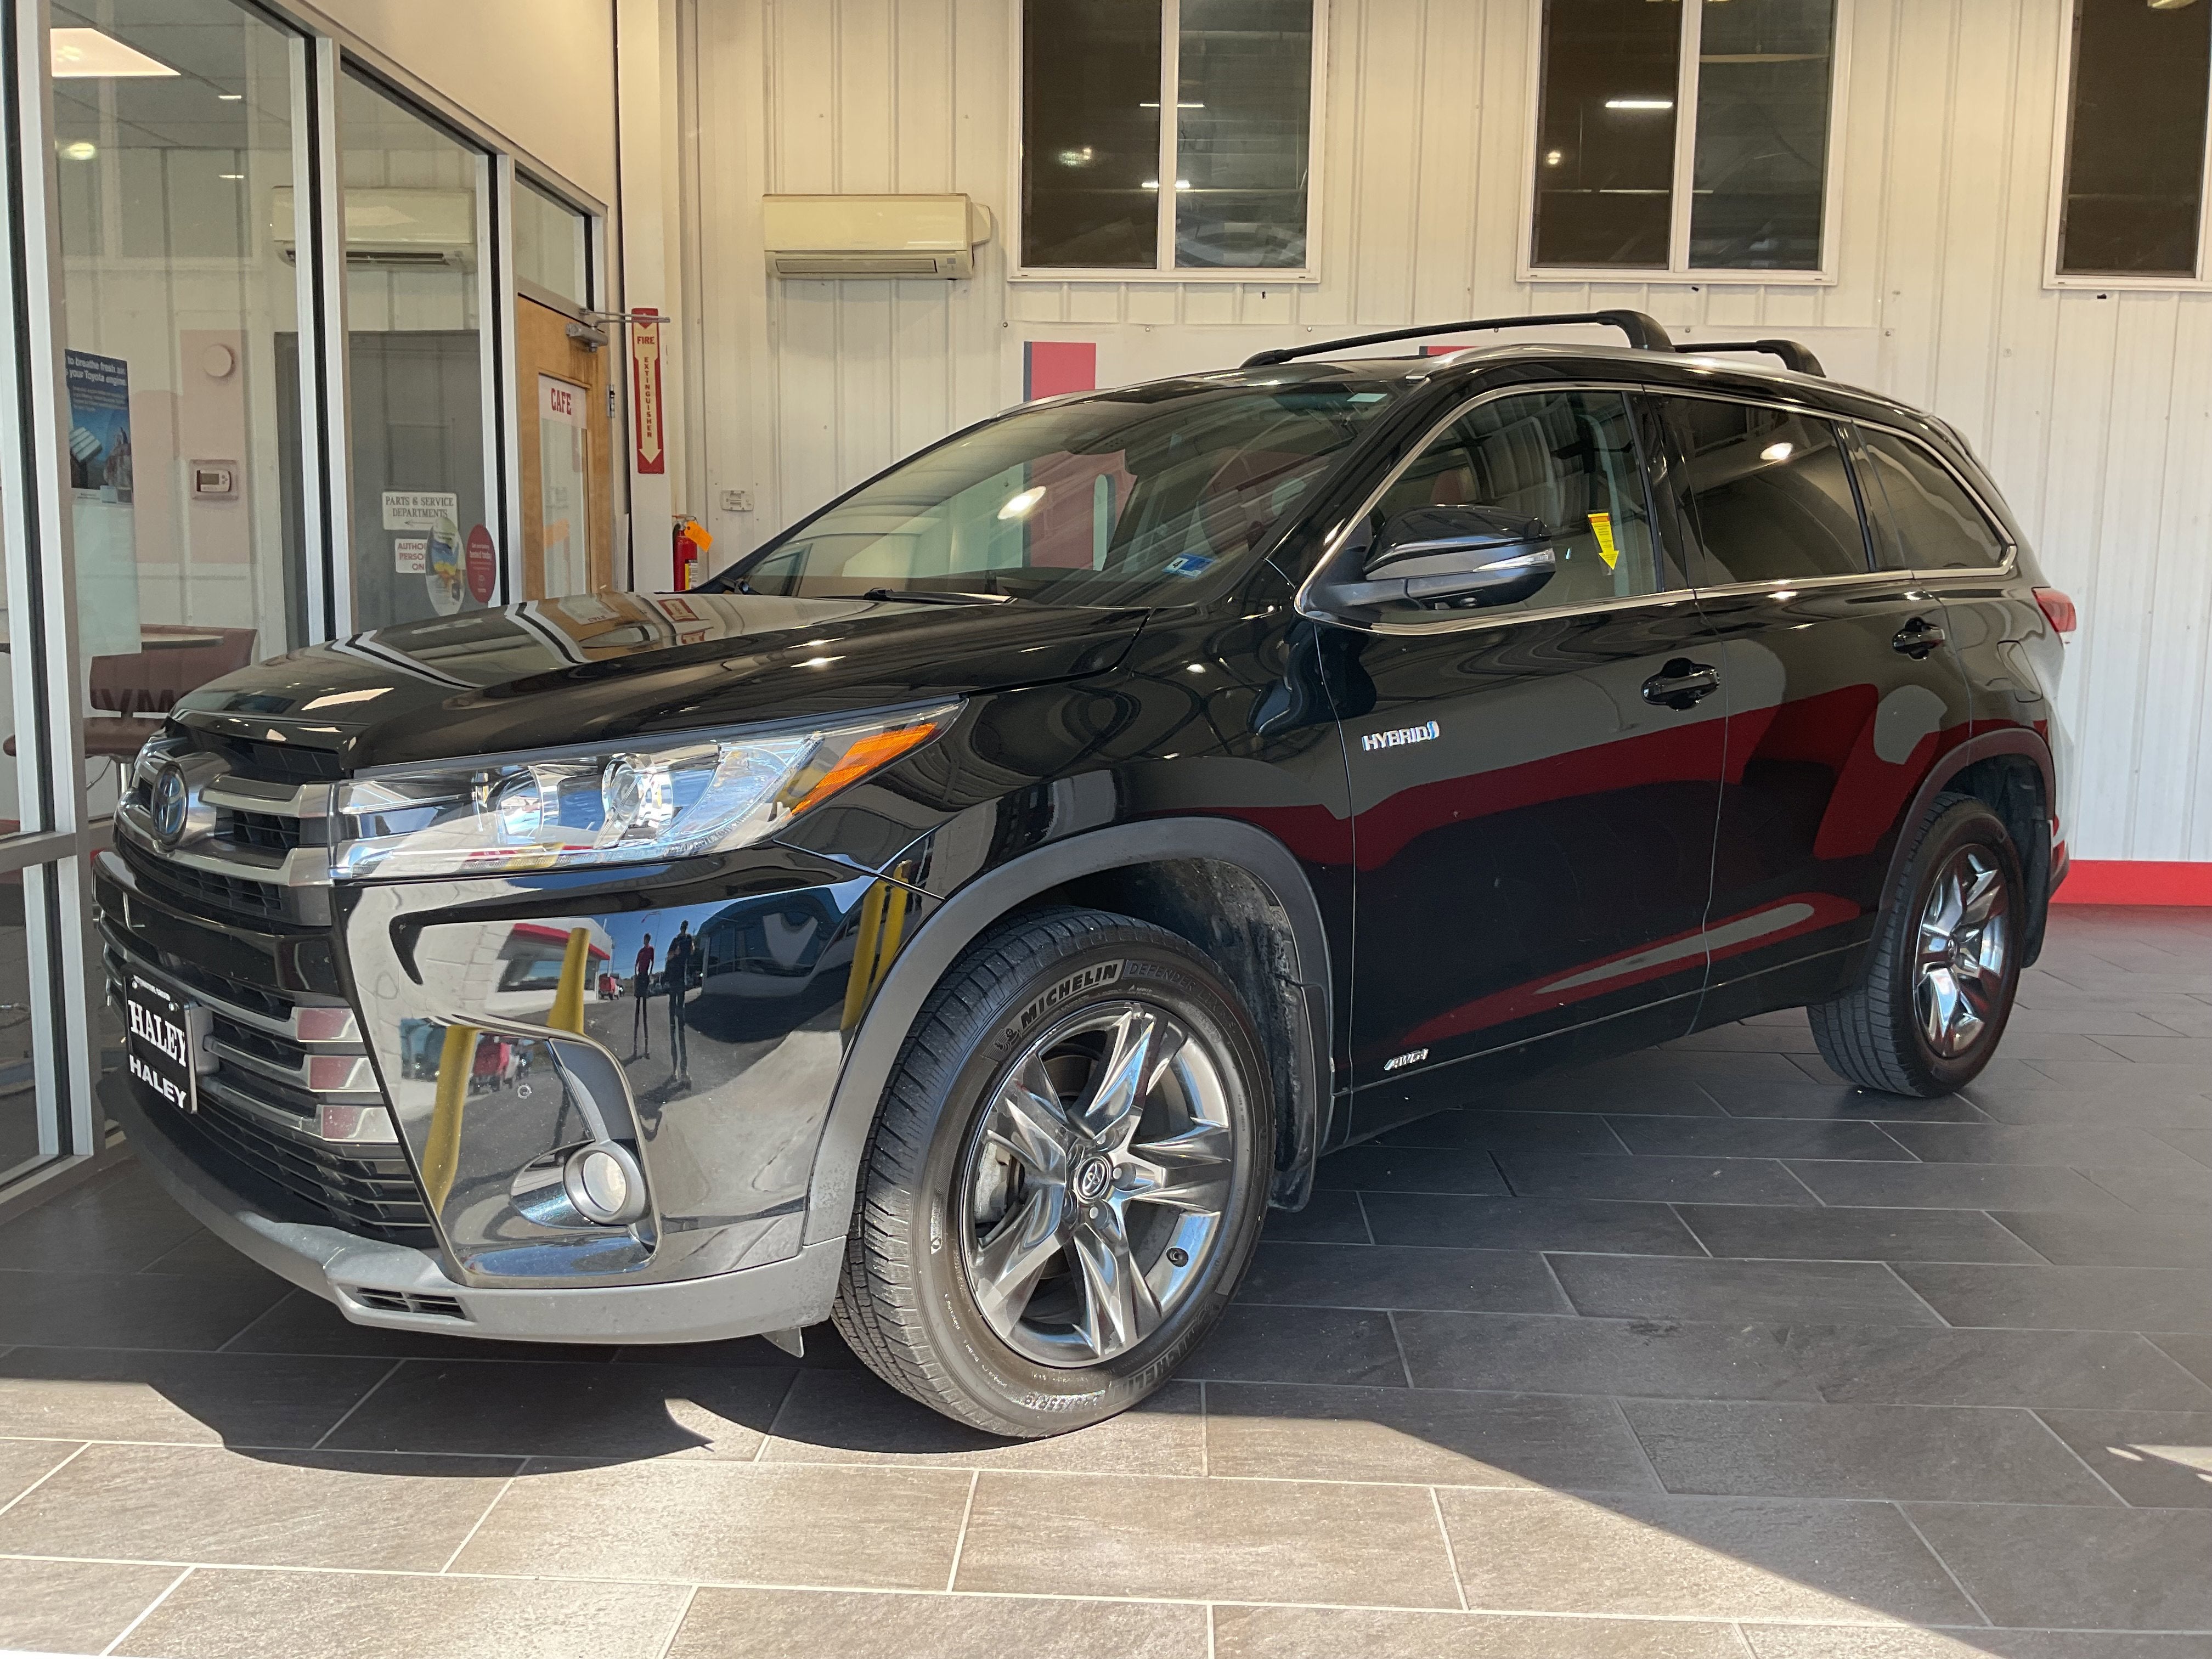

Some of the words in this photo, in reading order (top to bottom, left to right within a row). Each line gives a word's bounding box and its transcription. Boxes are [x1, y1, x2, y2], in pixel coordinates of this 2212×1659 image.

[637, 336, 655, 345] FIRE
[550, 387, 572, 415] CAFE
[644, 357, 653, 438] EXTINGUISHER
[386, 495, 409, 506] PARTS
[412, 497, 418, 506] &
[421, 496, 454, 507] SERVICE
[393, 507, 448, 518] DEPARTMENTS
[1172, 560, 1183, 568] 4
[1362, 725, 1431, 751] HYBRID
[1128, 962, 1197, 991] DEFENDER
[1020, 963, 1118, 1030] MICHELIN
[128, 1000, 187, 1068] HALEY
[129, 1053, 187, 1108] HALEY
